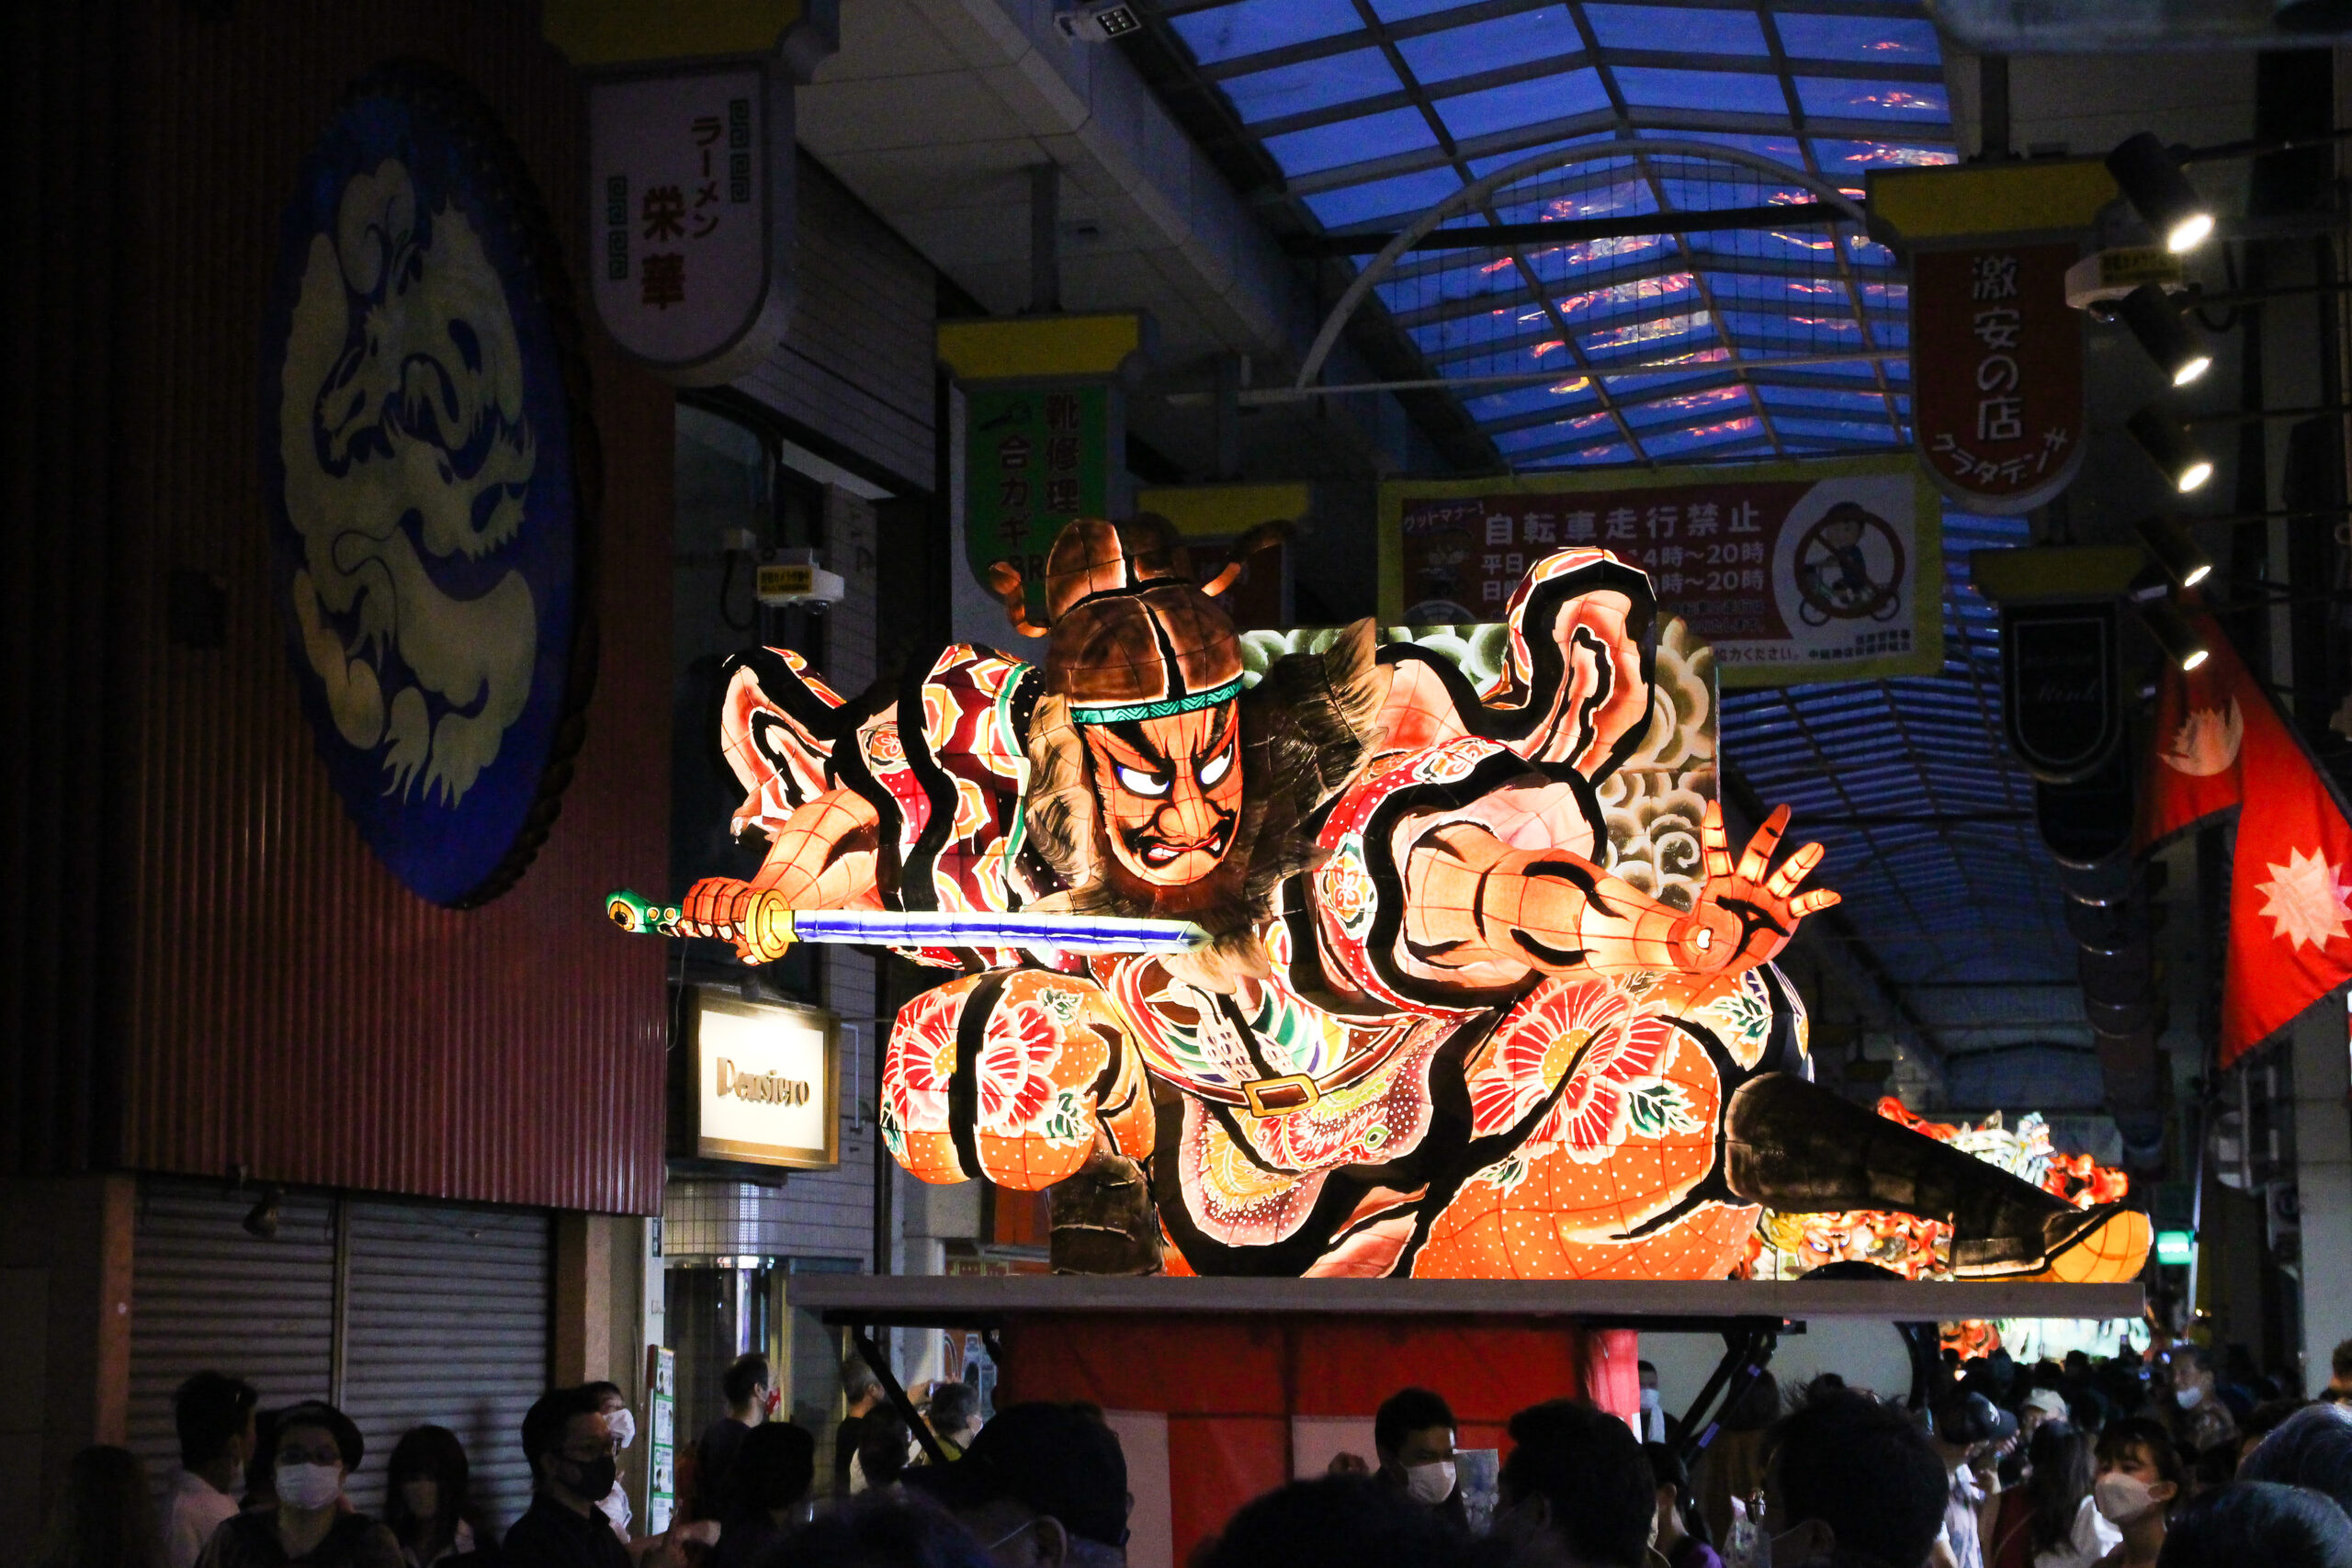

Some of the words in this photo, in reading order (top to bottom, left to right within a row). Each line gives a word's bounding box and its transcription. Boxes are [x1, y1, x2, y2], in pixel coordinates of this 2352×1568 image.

[691, 116, 722, 239] ラーメン
[641, 186, 686, 310] 栄華
[1972, 256, 2023, 441] 激安の店
[997, 434, 1033, 548] 合カギ
[1045, 393, 1080, 514] 靴修理
[1480, 552, 1524, 575] 平日
[1485, 500, 1763, 547] 自転車走行禁止
